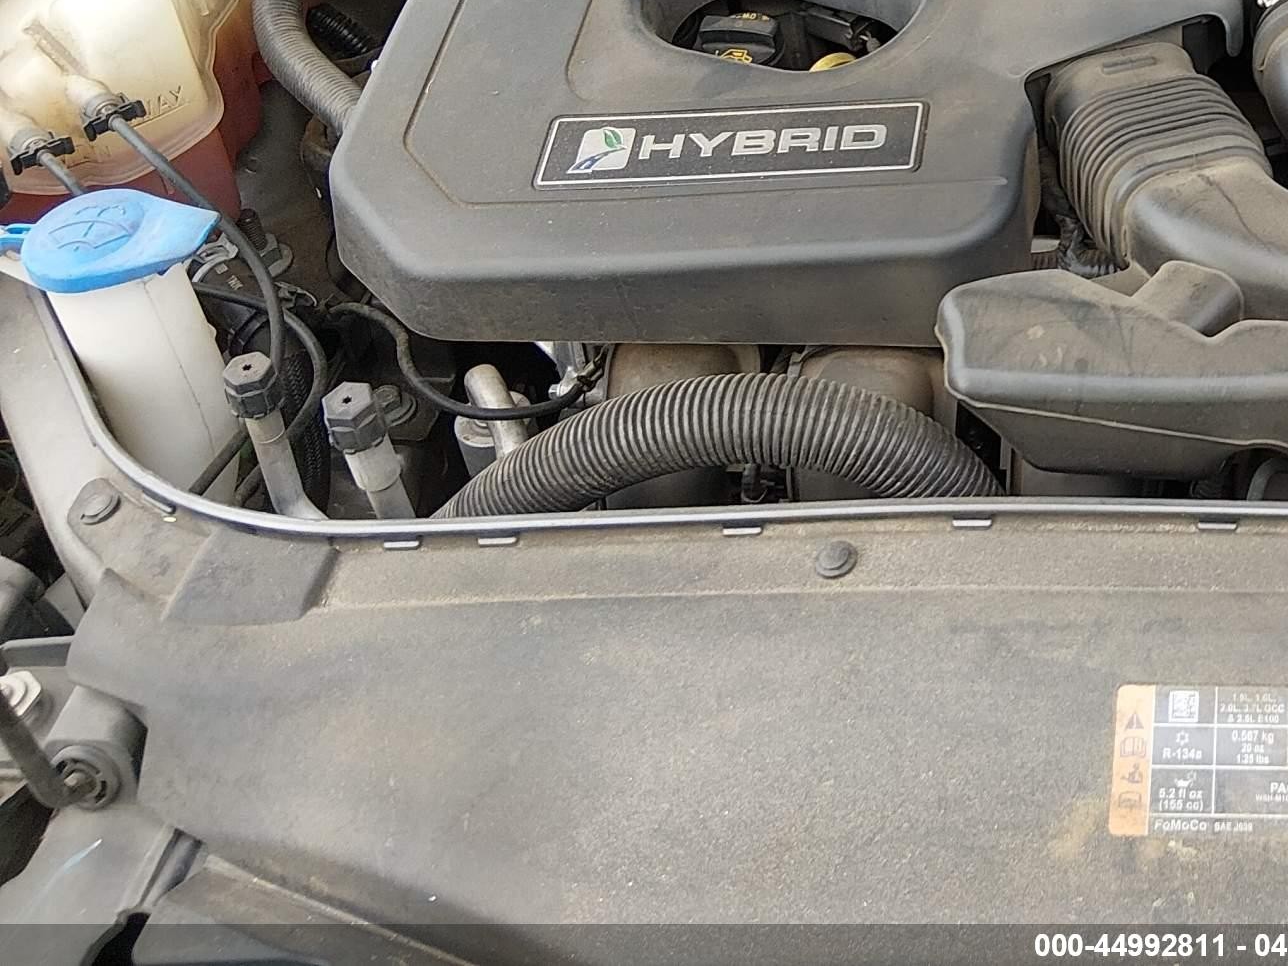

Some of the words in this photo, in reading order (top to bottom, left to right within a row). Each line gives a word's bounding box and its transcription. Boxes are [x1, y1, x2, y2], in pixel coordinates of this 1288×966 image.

[638, 124, 888, 161] HYBRID
[1261, 730, 1275, 745] kg
[1154, 819, 1208, 832] FoMoCo
